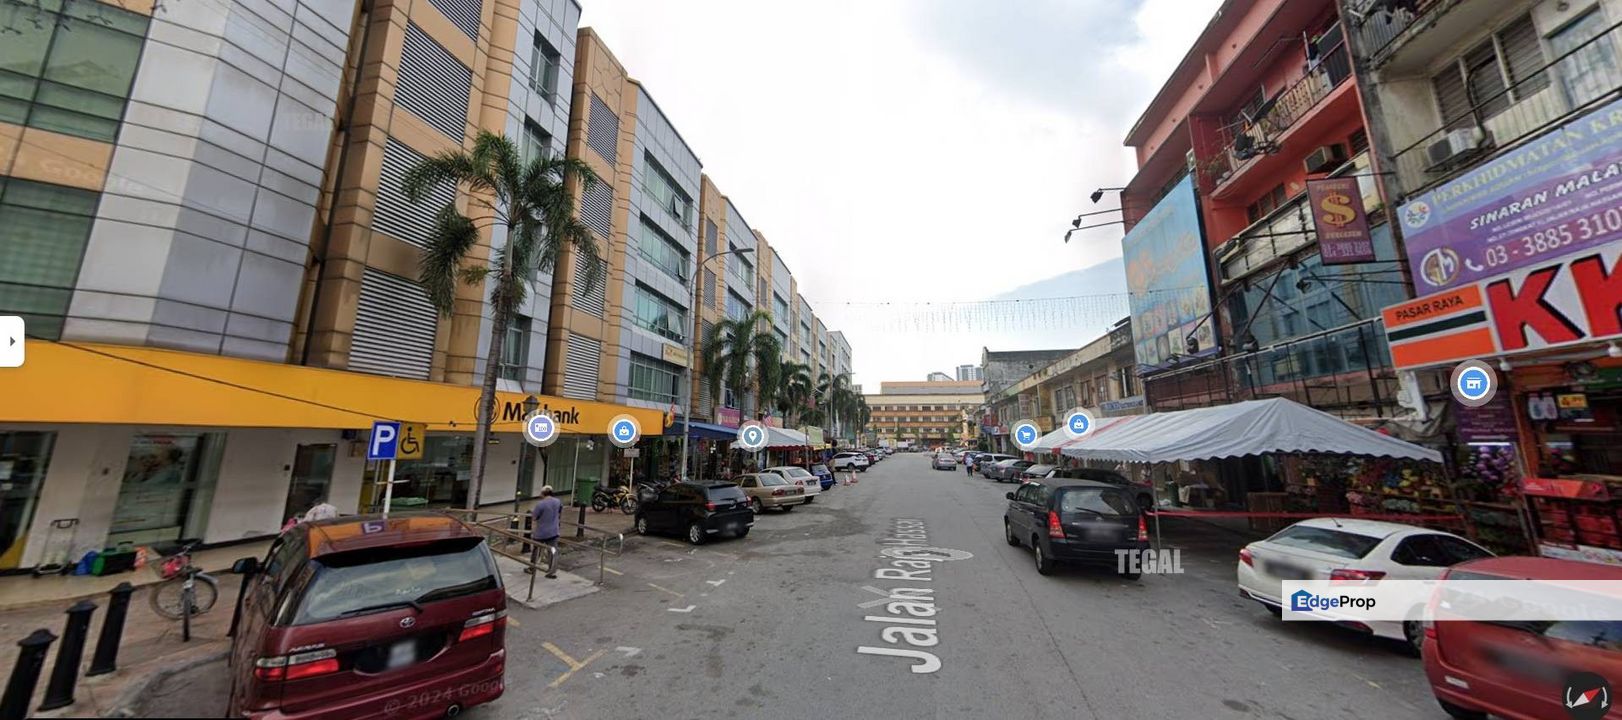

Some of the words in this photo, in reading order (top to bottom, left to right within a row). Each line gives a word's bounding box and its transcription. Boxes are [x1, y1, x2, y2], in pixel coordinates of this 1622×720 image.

[1470, 191, 1548, 230] SINARAN
[1556, 162, 1622, 197] MALA
[1486, 245, 1508, 266] 03
[1521, 224, 1573, 257] 3885
[1577, 206, 1622, 239] 310
[1395, 303, 1430, 321] PASAR
[1434, 295, 1464, 312] RAYA
[372, 425, 396, 456] P
